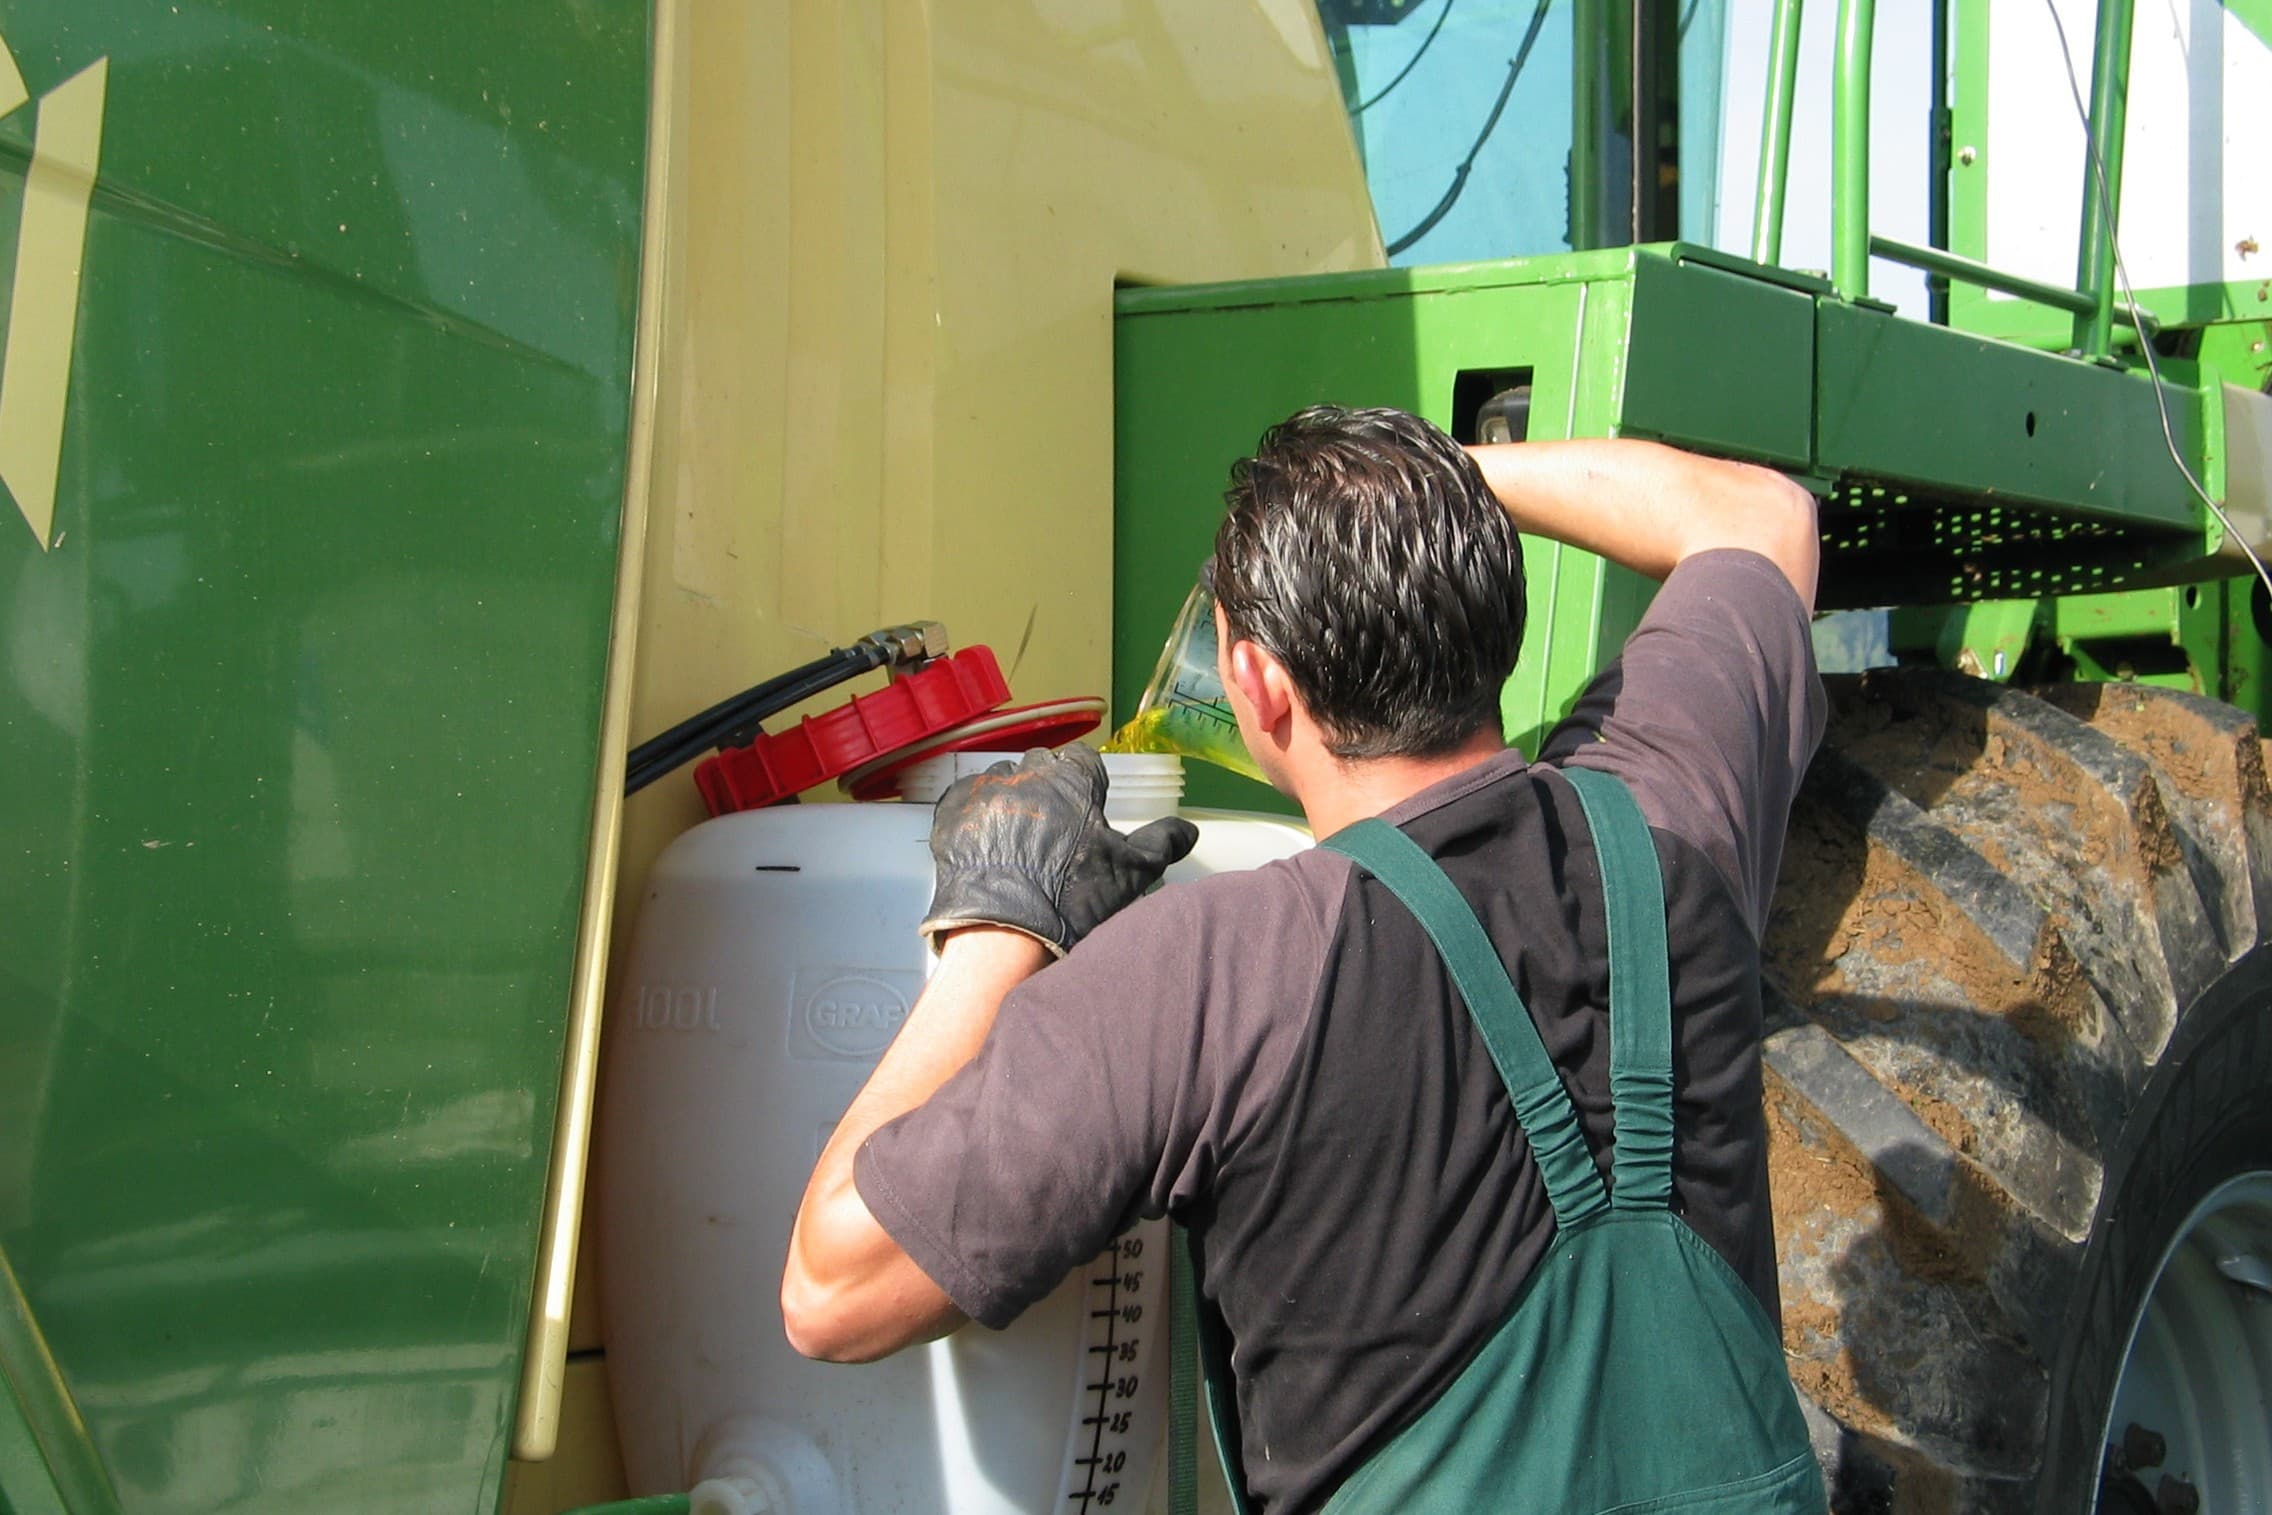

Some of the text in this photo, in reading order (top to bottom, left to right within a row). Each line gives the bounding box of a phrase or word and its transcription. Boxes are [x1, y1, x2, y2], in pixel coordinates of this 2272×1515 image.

[814, 999, 901, 1030] GRAF
[1122, 1238, 1143, 1259] 50
[1123, 1271, 1142, 1292] 45
[1122, 1305, 1142, 1324] 40
[1117, 1340, 1139, 1362] 35
[1115, 1376, 1139, 1398] 30
[1110, 1412, 1132, 1434] 25
[1102, 1452, 1127, 1474] 20
[1097, 1483, 1120, 1505] 15
